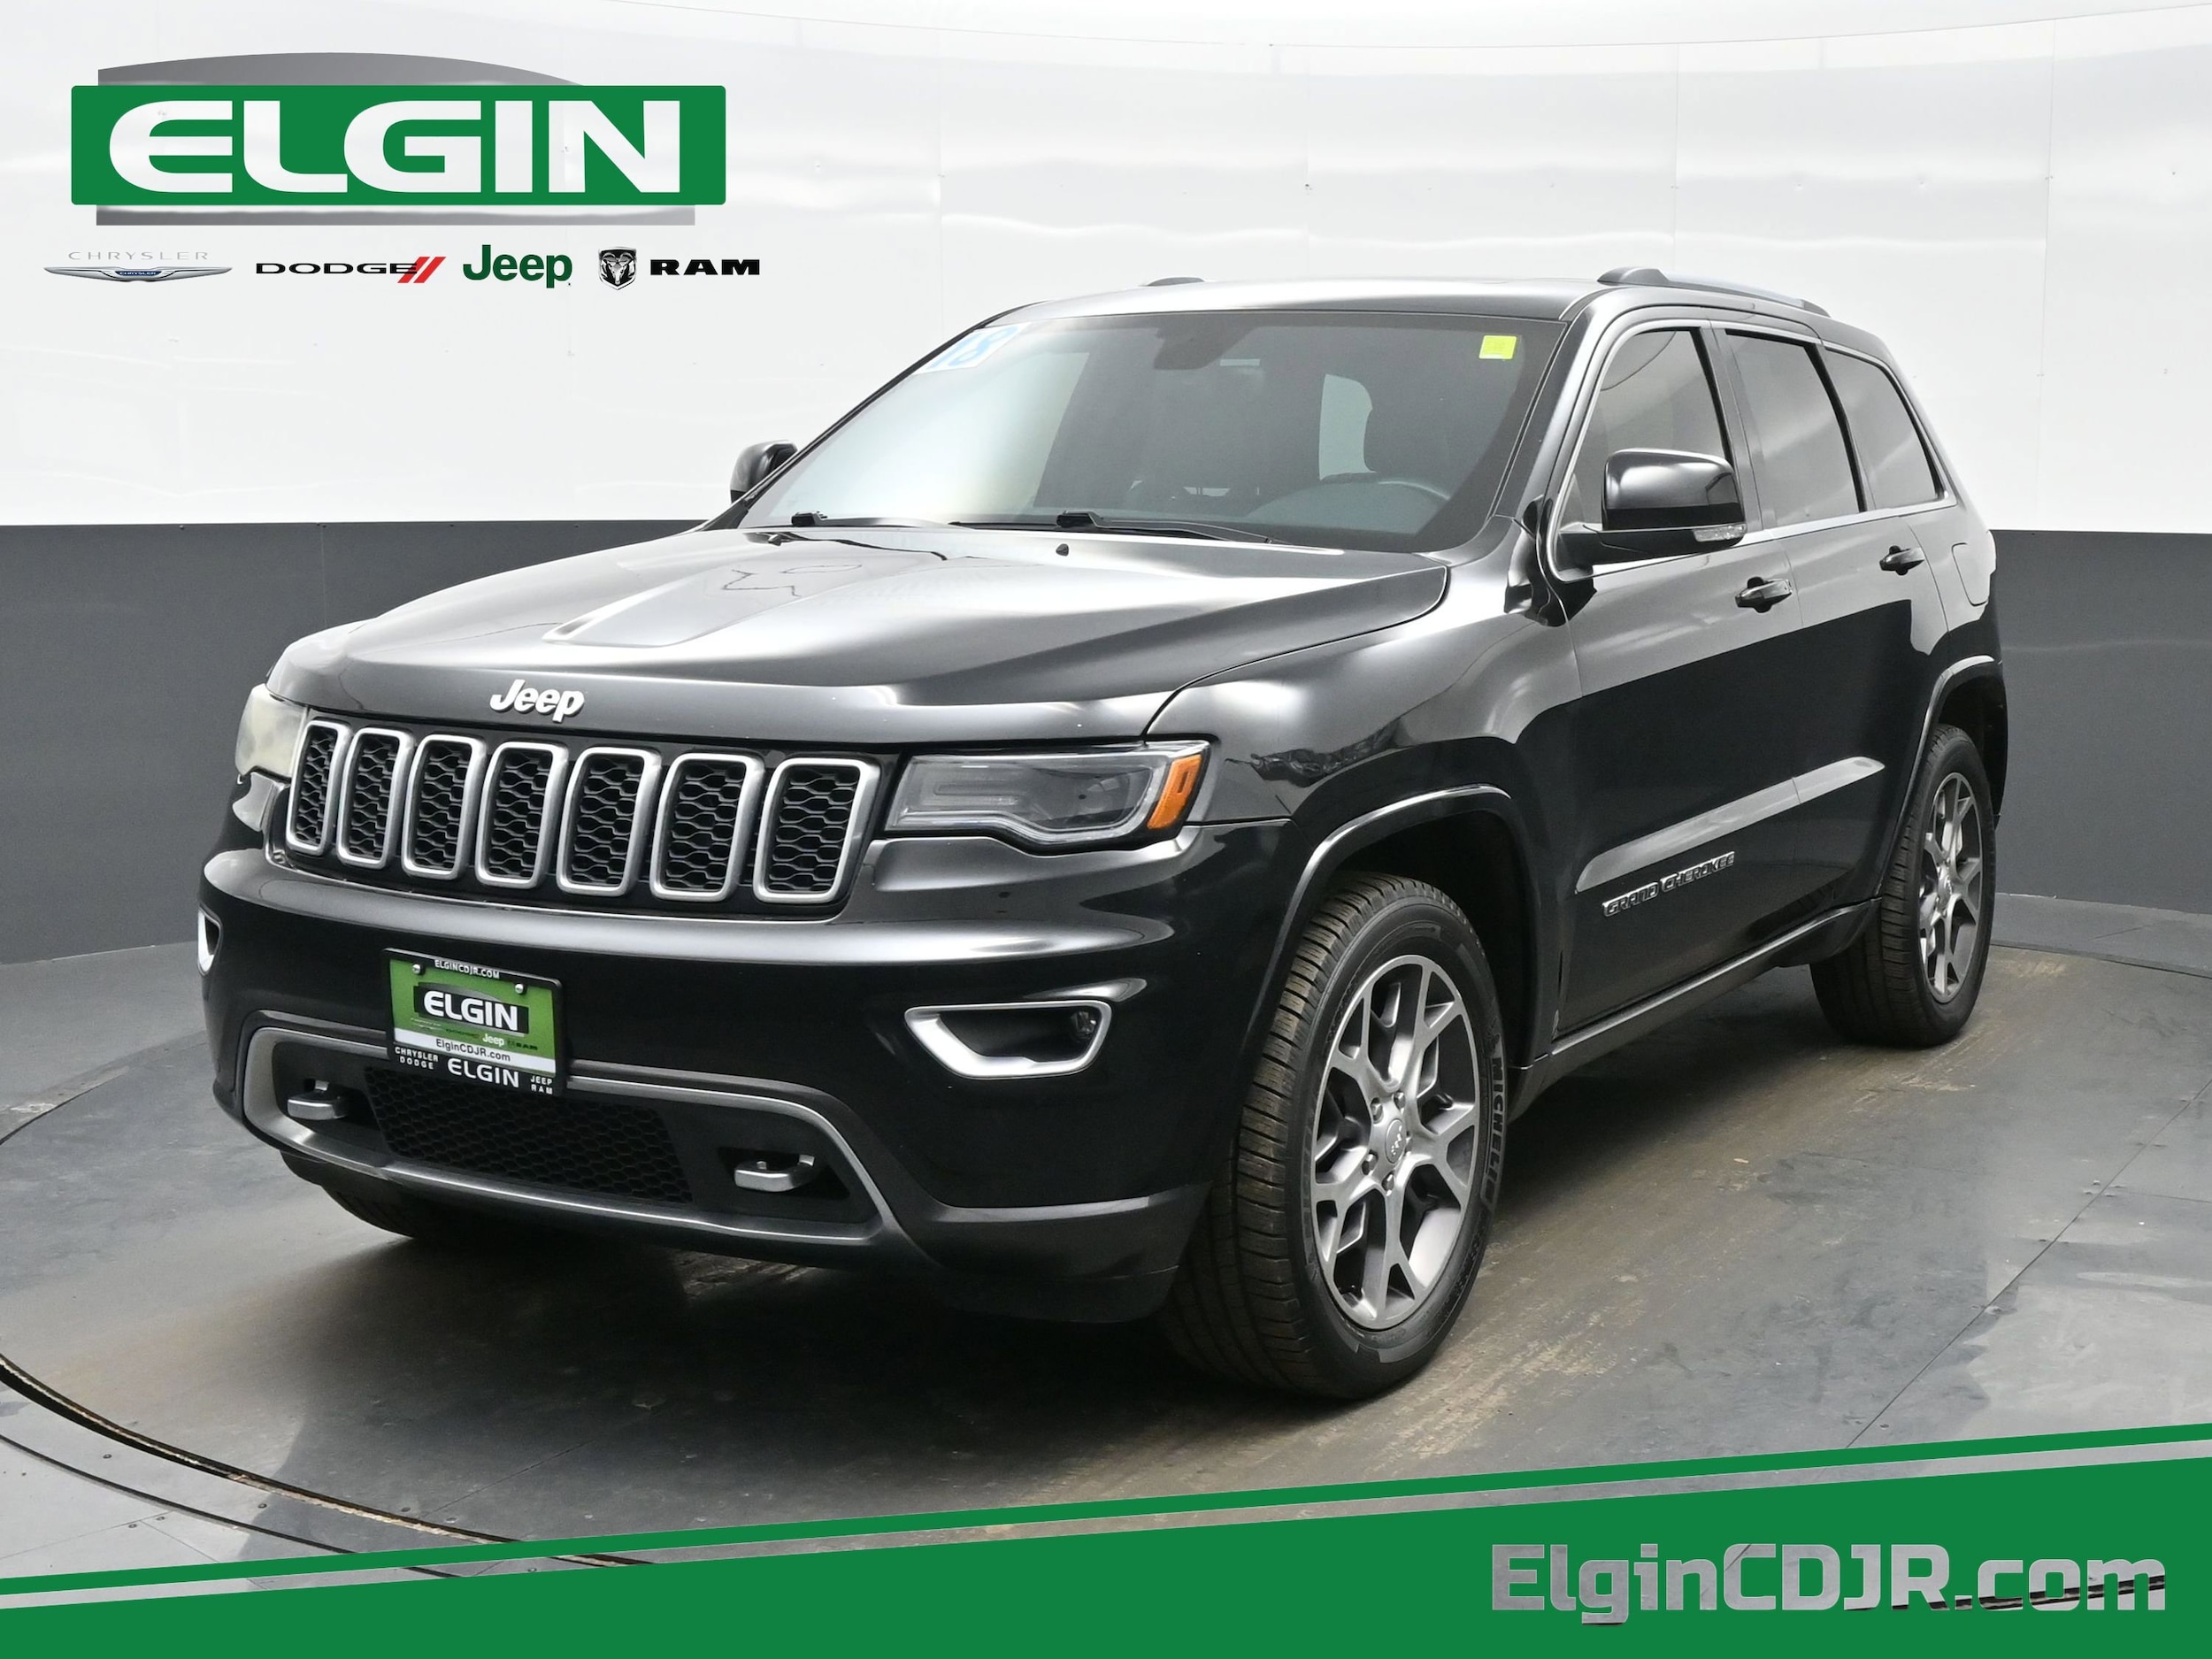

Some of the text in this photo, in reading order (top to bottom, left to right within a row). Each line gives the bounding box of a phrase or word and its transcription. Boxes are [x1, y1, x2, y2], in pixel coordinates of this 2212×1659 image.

[489, 679, 585, 723] Jeep
[1601, 851, 1735, 918] GRAND CHEROKEE
[434, 959, 500, 979] ELGINCDJR.COM
[424, 990, 518, 1031] ELGIN
[435, 1038, 511, 1062] ElginCDJR.com
[482, 1033, 505, 1047] Jeep
[395, 1047, 439, 1063] CHRYSLER
[400, 1056, 434, 1070] DODGE
[448, 1058, 519, 1088] ELGIN
[530, 1075, 553, 1086] JEEP
[531, 1085, 553, 1095] RAM
